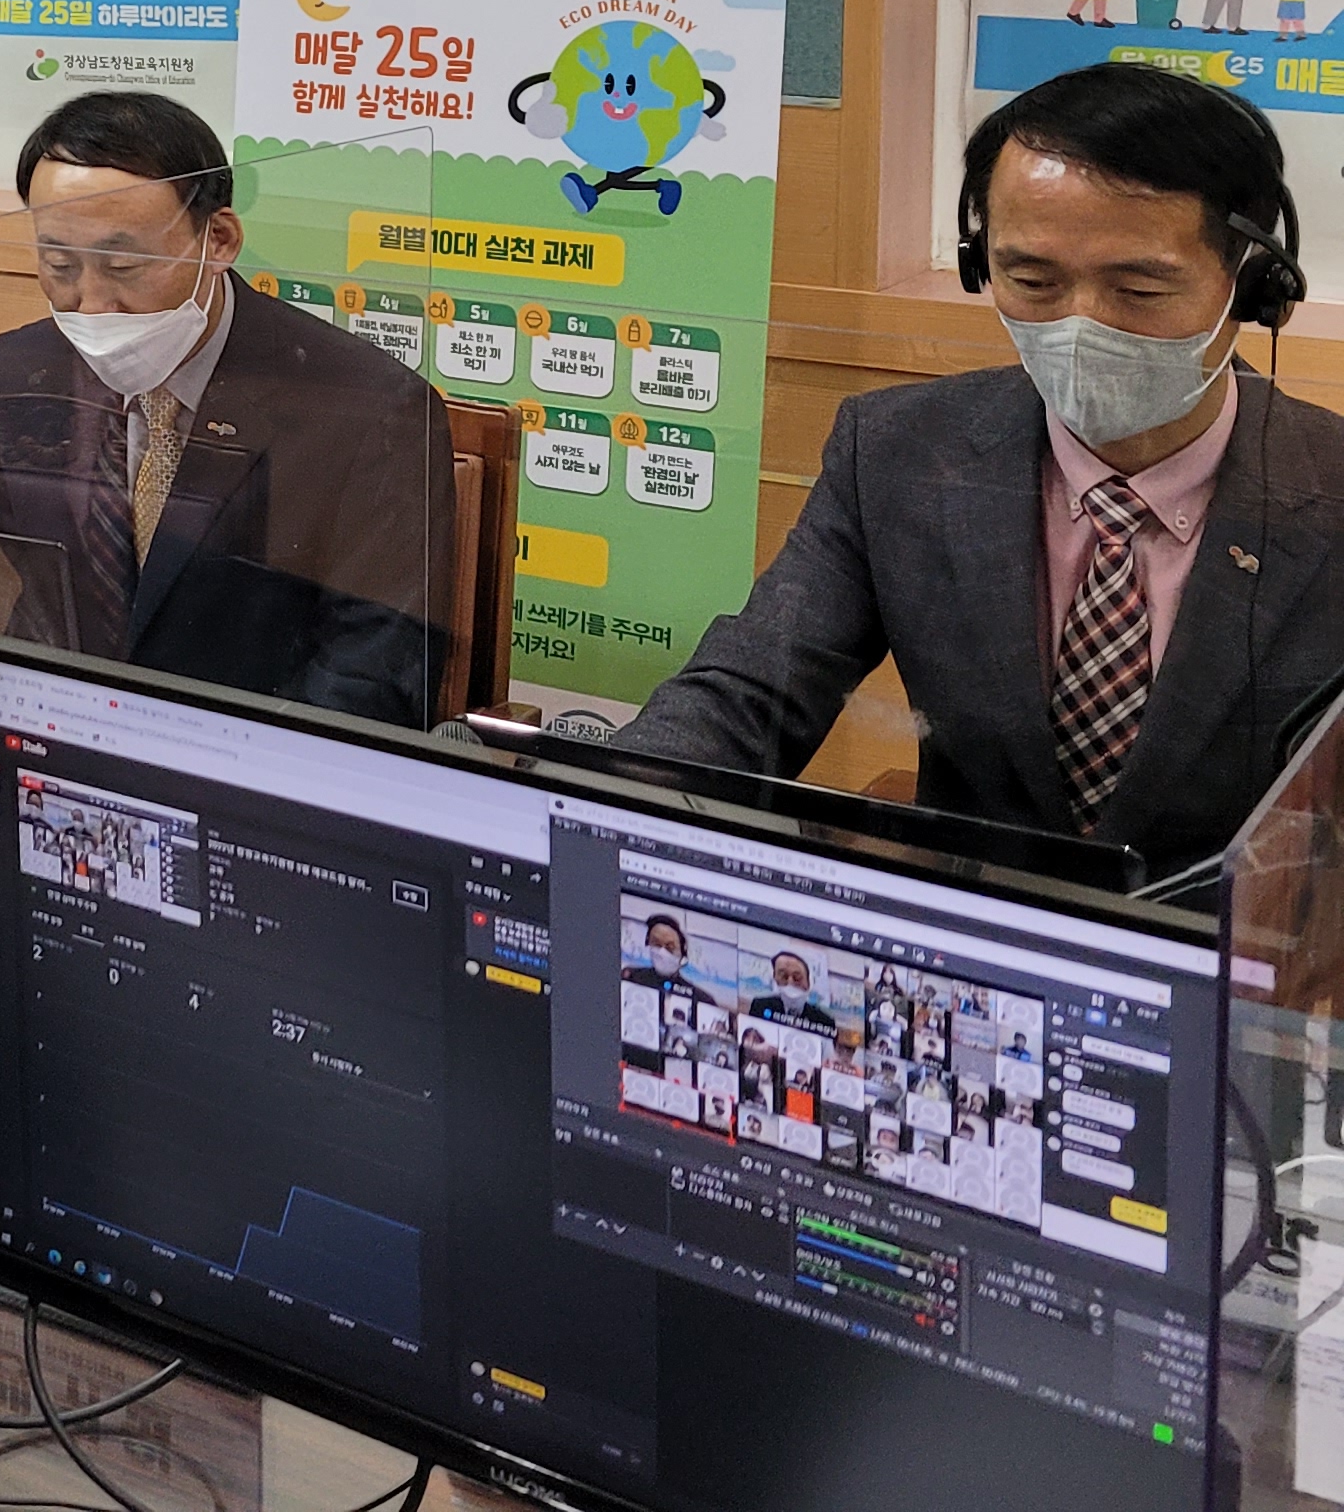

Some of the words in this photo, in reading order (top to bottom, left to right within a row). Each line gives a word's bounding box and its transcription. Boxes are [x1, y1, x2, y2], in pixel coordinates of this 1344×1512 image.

[40, 0, 92, 26] 25일
[98, 4, 228, 28] 하루만이라도
[559, 6, 592, 29] ECO
[597, 0, 660, 17] DREAM
[664, 9, 697, 33] DAY
[295, 31, 363, 75] 매달
[376, 25, 474, 82] 25일
[64, 55, 194, 72] 경상남도창원교육지원청
[1230, 56, 1264, 75] 25
[293, 80, 346, 114] 함께
[356, 84, 473, 120] 실천해요!
[379, 224, 427, 252] 월별
[431, 229, 477, 258] 10대
[485, 235, 535, 263] 실천
[541, 241, 594, 270] 과제
[292, 284, 310, 300] 3월
[380, 295, 399, 311] 4월
[470, 305, 489, 321] 5월
[567, 316, 588, 333] 6월
[383, 335, 418, 351] 장바구니
[459, 330, 475, 341] 채소
[476, 332, 485, 343] 한
[669, 328, 691, 345] 7월
[450, 342, 472, 356] 최소
[475, 344, 488, 358] 한
[489, 347, 501, 360] 끼
[551, 347, 567, 359] 우리
[579, 350, 596, 362] 음식
[463, 358, 486, 372] 먹기
[541, 359, 578, 375] 국내산
[580, 362, 604, 378] 먹기
[659, 356, 693, 370] 플라스틱
[657, 369, 694, 385] 올바른
[639, 381, 684, 398] 분리배출
[687, 386, 711, 402] 하기
[558, 412, 588, 430] 11월
[659, 426, 691, 445] 12월
[552, 444, 585, 457] 아무것도
[535, 455, 559, 469] 사지
[561, 458, 586, 473] 않는
[588, 460, 601, 475] 날
[648, 453, 666, 466] 내가
[667, 456, 694, 469] 만드는
[644, 480, 695, 499] 실천하기
[527, 603, 607, 637] 쓰레기를
[611, 618, 672, 650] 주우며
[511, 631, 575, 661] 지켜요!
[272, 1019, 306, 1043] 2:37
